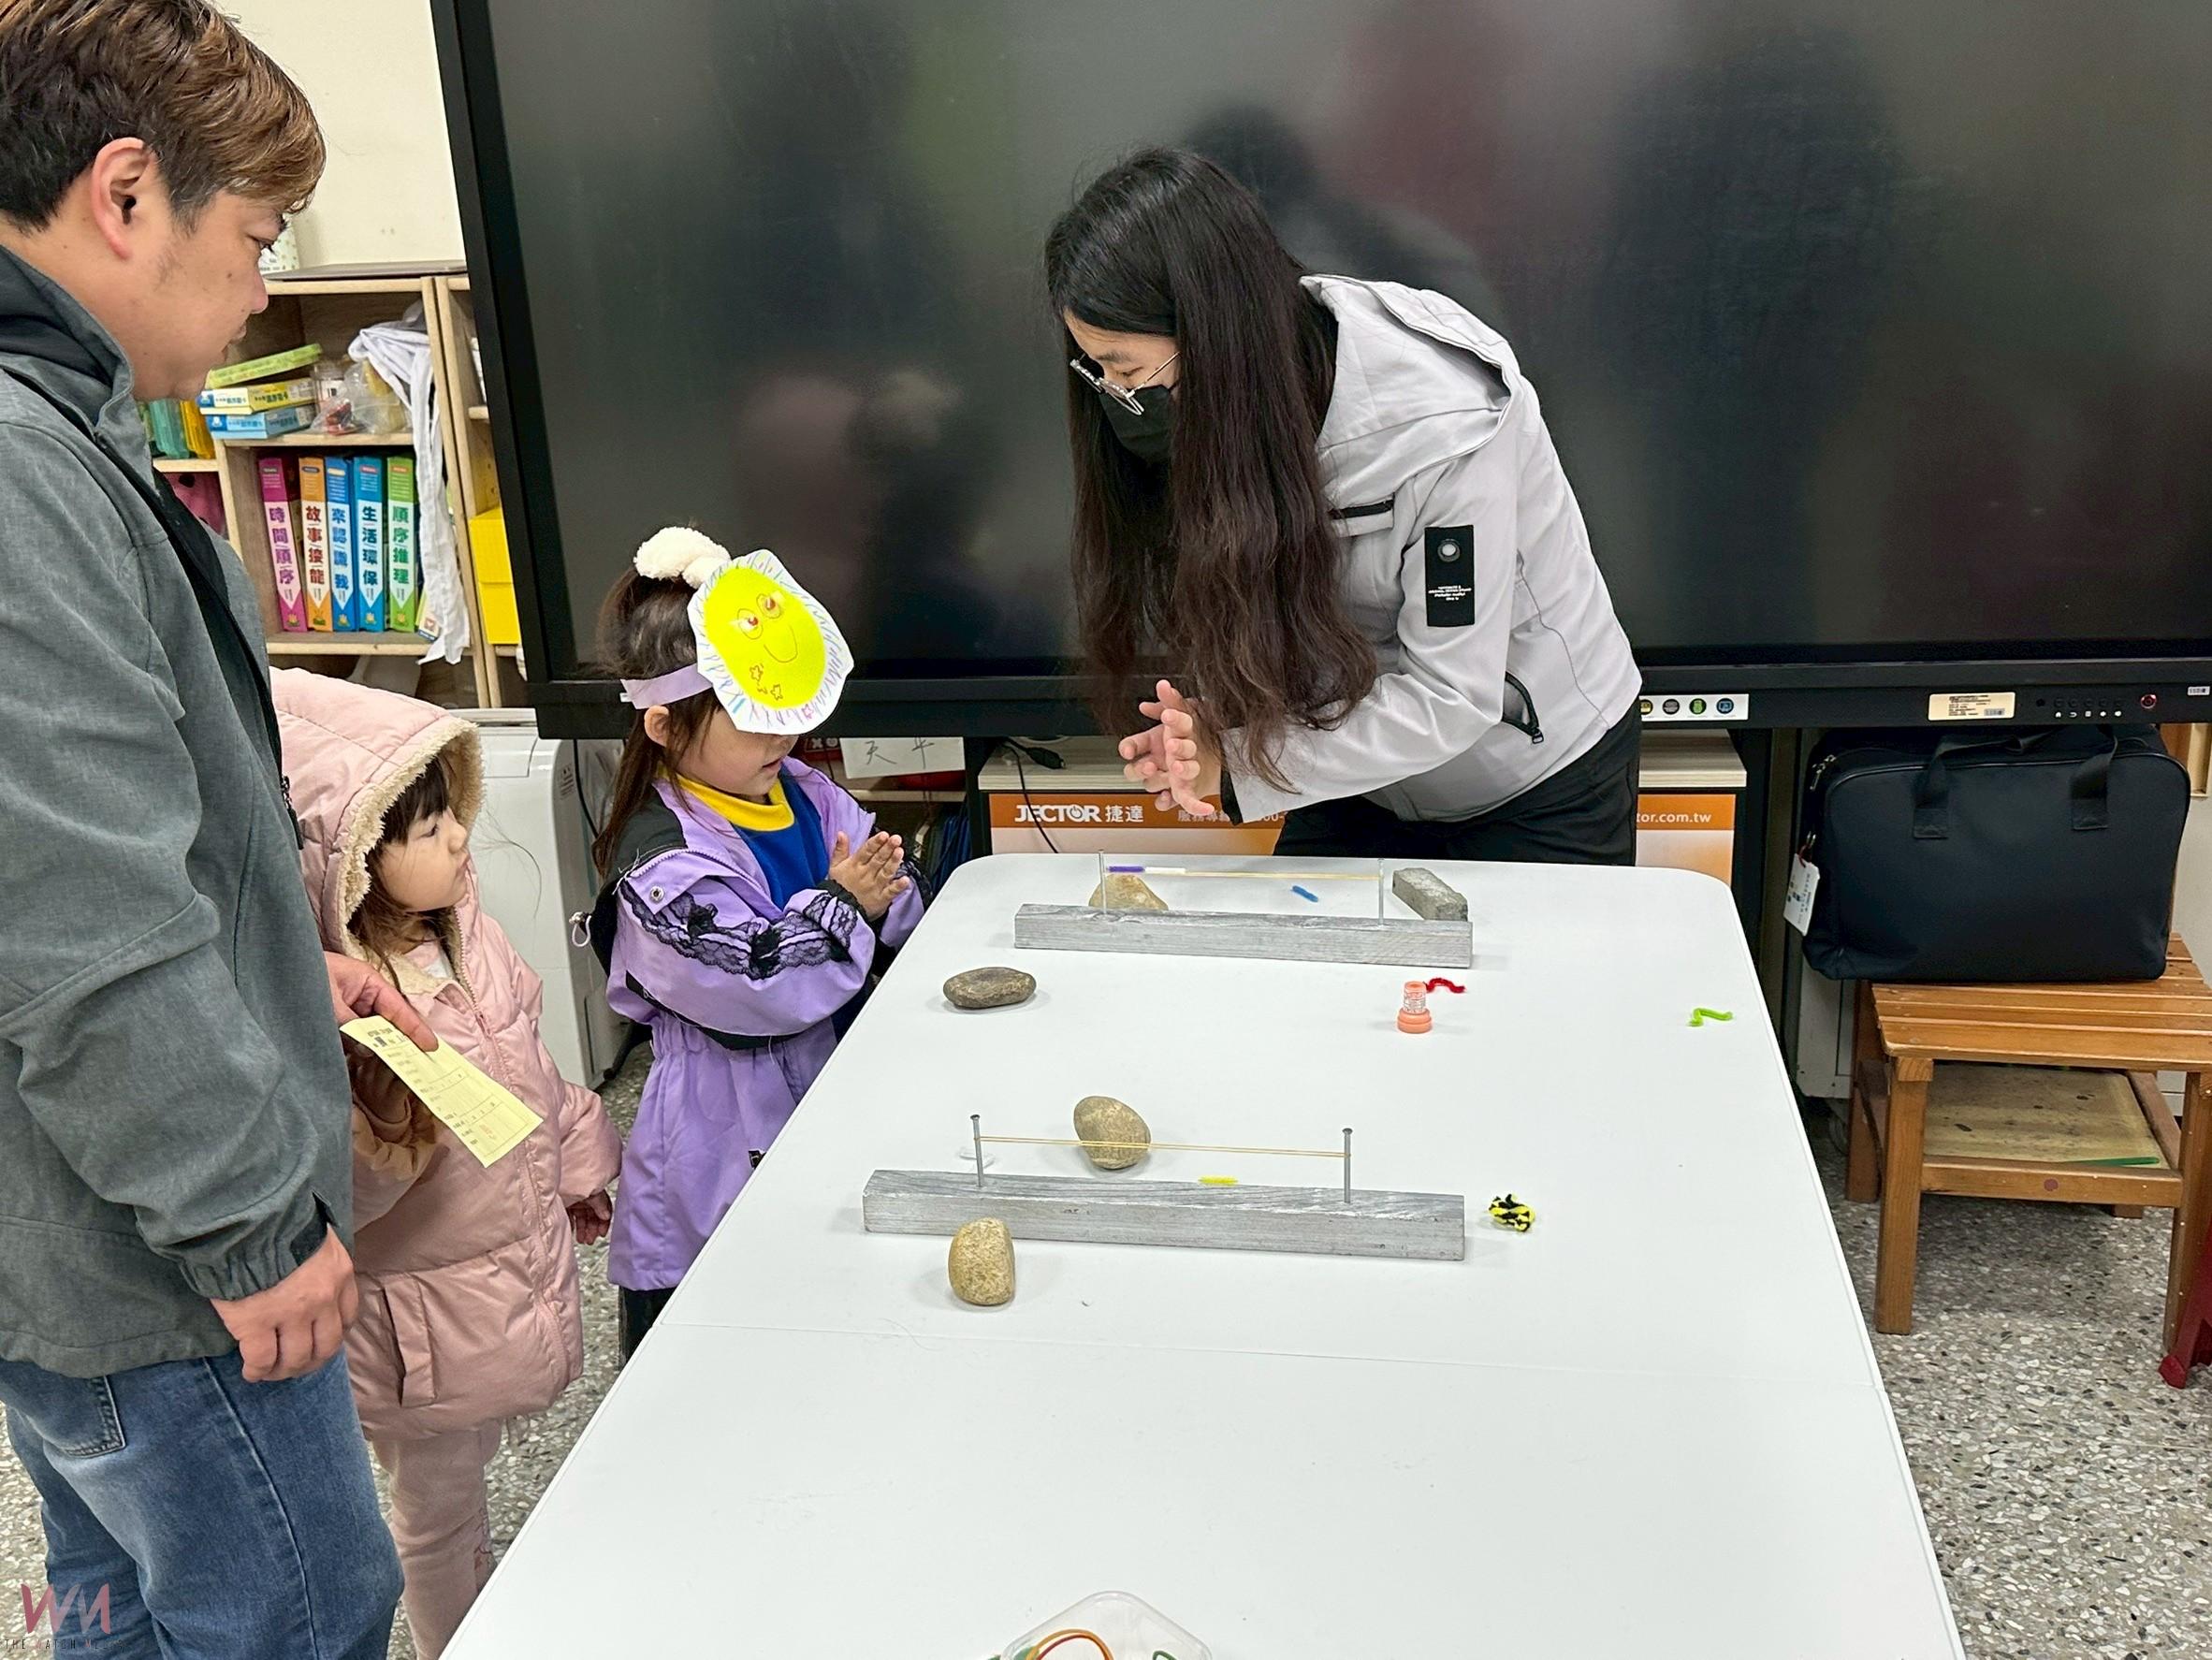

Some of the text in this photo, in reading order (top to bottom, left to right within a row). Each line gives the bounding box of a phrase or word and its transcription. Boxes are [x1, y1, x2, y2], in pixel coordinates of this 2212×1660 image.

[362, 506, 378, 586] 生活環保
[392, 505, 410, 585] 順序推理
[1014, 804, 1144, 823] JECTOR 捷達
